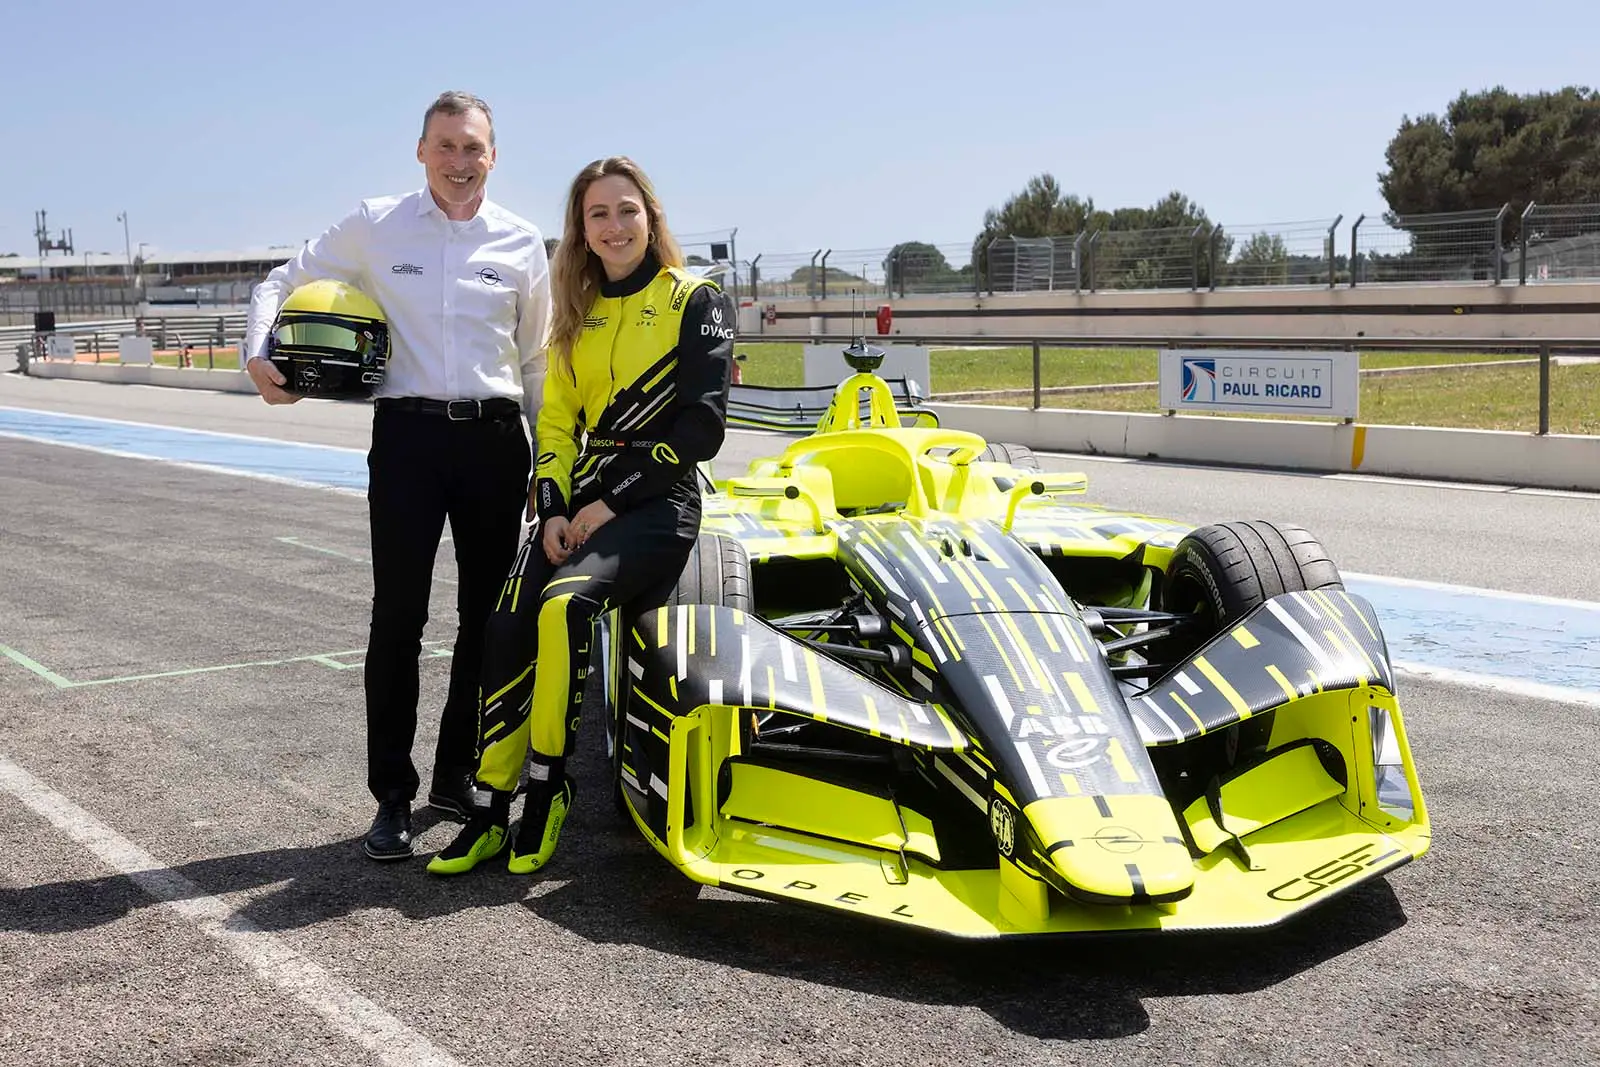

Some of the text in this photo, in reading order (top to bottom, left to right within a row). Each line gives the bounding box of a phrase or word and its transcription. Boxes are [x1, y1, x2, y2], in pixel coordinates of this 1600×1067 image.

[700, 324, 734, 339] DVAG
[1222, 366, 1321, 379] CIRCUIT
[1223, 383, 1321, 398] PAUL RICARD
[611, 471, 642, 496] sparco
[570, 641, 589, 731] OPEL
[1018, 715, 1110, 738] ABB
[991, 804, 1013, 850] FIA
[1266, 843, 1402, 902] GSE
[731, 868, 915, 918] OPEL
